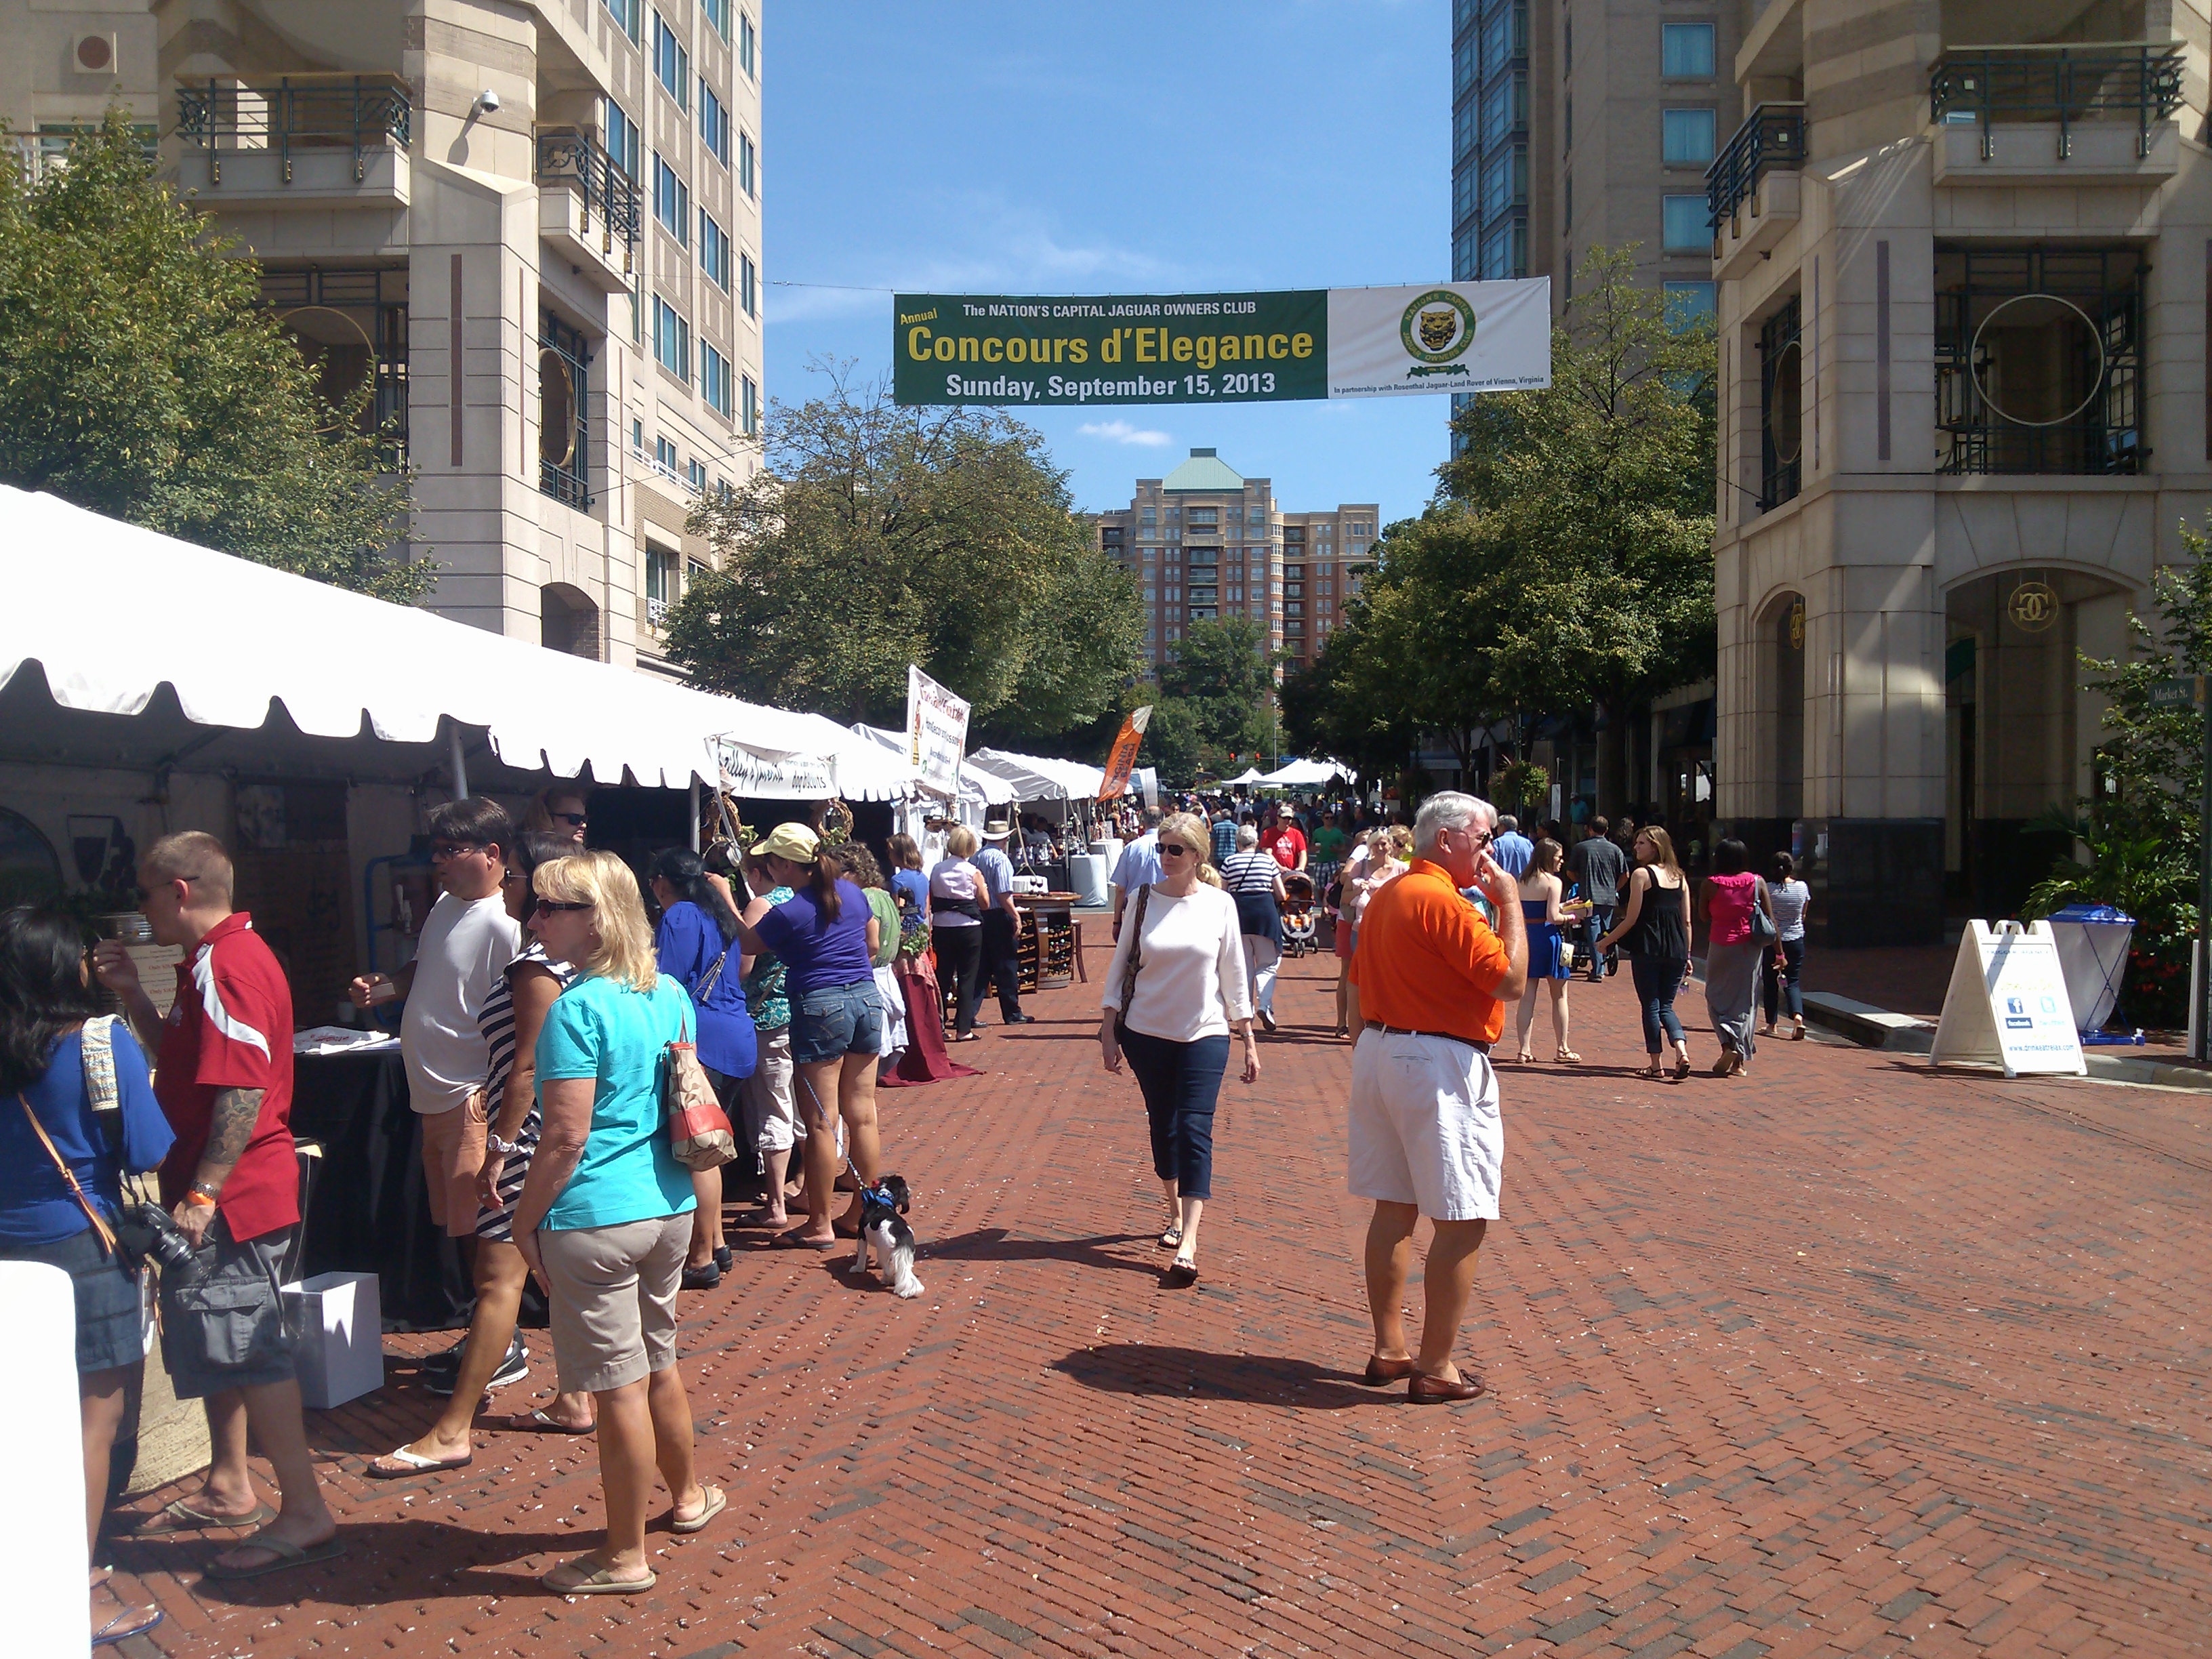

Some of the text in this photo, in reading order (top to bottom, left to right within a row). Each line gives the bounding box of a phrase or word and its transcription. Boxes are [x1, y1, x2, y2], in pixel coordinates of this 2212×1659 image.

[900, 307, 937, 325] Annual
[963, 302, 1256, 317] The NATION'S CAPITAL JAGUAR OWNERS CLUB
[1445, 293, 1471, 318] CAPITAL
[907, 326, 1313, 370] Concours d'Elegance
[1403, 329, 1473, 361] JAGUAR OWNERS CLUB
[946, 373, 1275, 402] Sunday, September 15, 2013
[1341, 385, 1377, 394] partnership
[1393, 382, 1425, 390] Rosenthal
[1425, 380, 1465, 390] Jaguar-Land
[1493, 377, 1517, 385] Vienna,
[1518, 375, 1544, 384] Virginia
[2154, 685, 2188, 701] Market St.
[1120, 743, 1136, 778] BEACH
